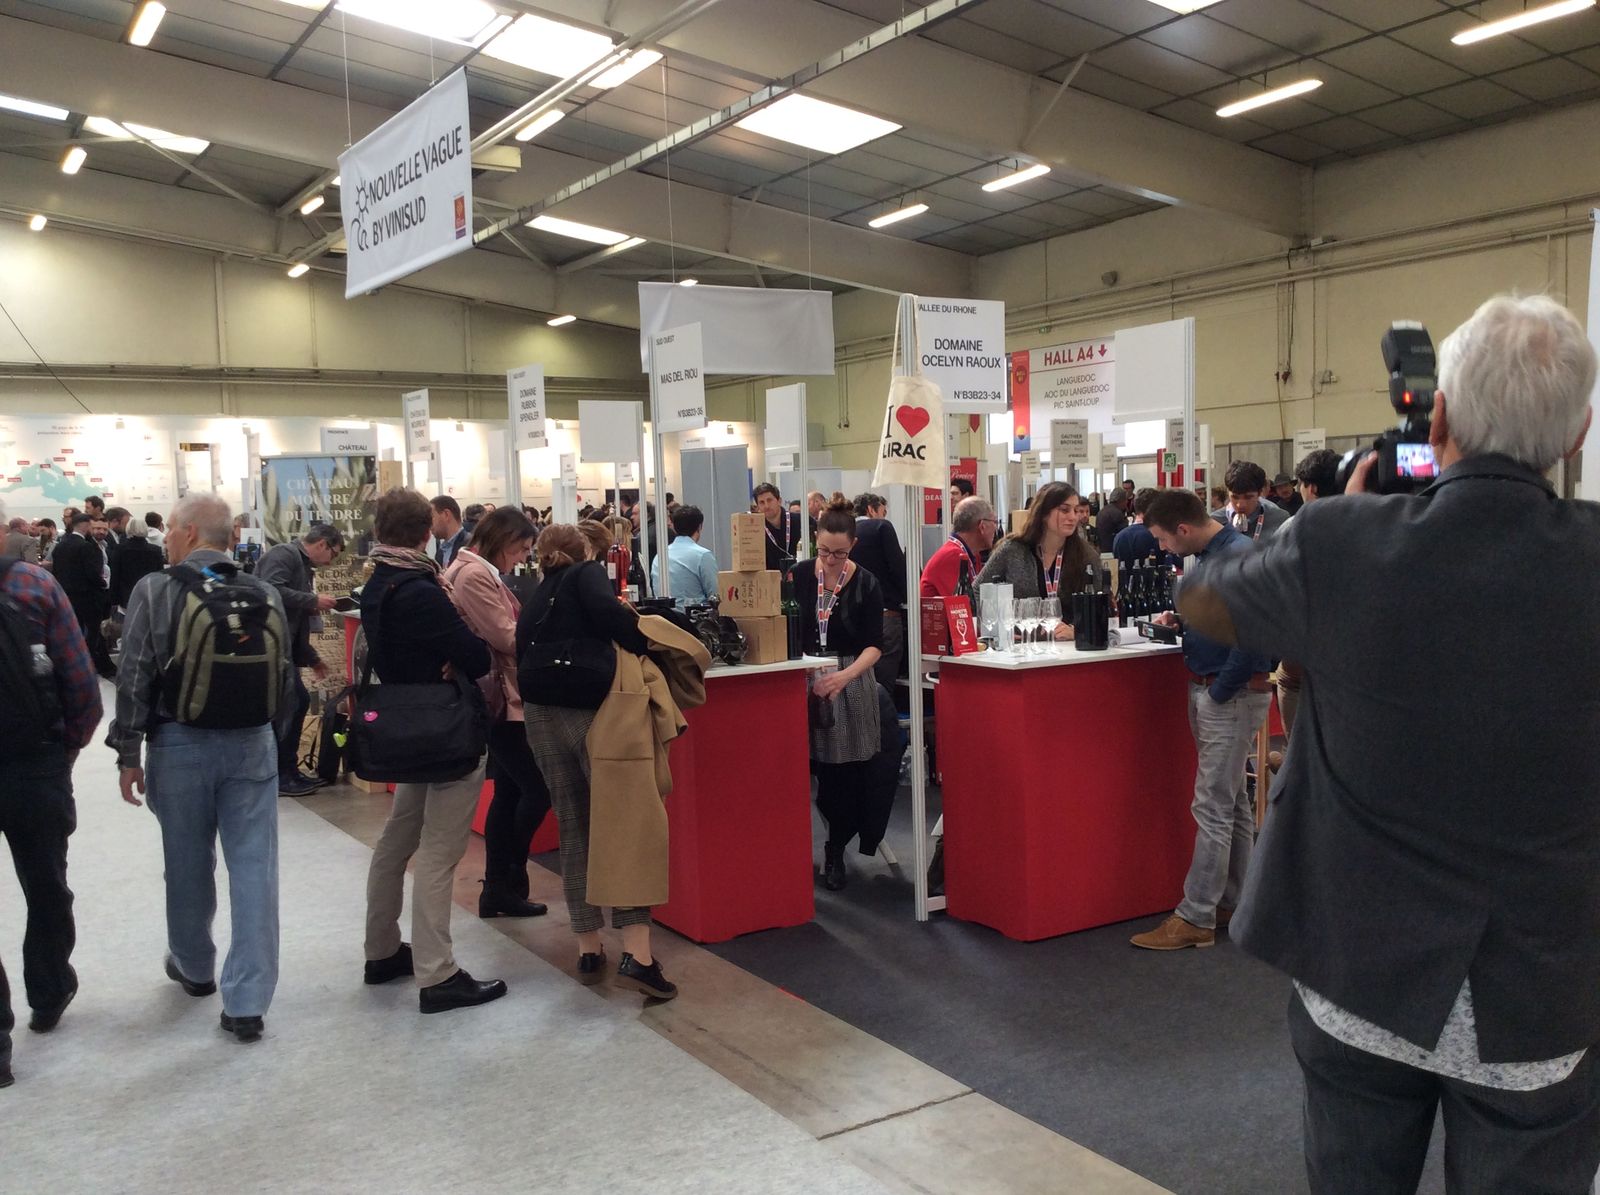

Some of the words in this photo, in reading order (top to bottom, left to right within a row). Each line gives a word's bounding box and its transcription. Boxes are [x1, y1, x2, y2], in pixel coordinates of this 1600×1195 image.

[369, 151, 422, 206] NOUVELLE
[422, 125, 463, 174] VAGUE
[372, 217, 384, 247] BY
[385, 195, 426, 239] VINISUD
[918, 304, 940, 313] ALLEE
[942, 305, 951, 313] DU
[953, 305, 977, 315] RHONE
[934, 338, 983, 352] DOMAINE
[921, 354, 964, 368] OCELYN
[966, 356, 1001, 369] RAOUX
[1044, 350, 1074, 367] HALL
[1077, 345, 1094, 362] A4
[660, 372, 672, 384] MAS
[673, 370, 684, 382] DEL
[684, 367, 698, 380] RIOU
[1056, 373, 1097, 386] LANGUEDOC
[1044, 390, 1059, 399] AOC
[1059, 389, 1069, 398] DU
[1070, 383, 1110, 395] LANGUEDOC
[1053, 400, 1065, 409] PIC
[1065, 397, 1100, 409] SAINT-LOUP
[885, 405, 894, 439] I
[882, 441, 926, 460] LIRAC
[286, 476, 353, 489] CHÂTEAU
[291, 493, 352, 505] MOURRE
[286, 510, 303, 521] DU
[308, 509, 363, 521] TENDRE
